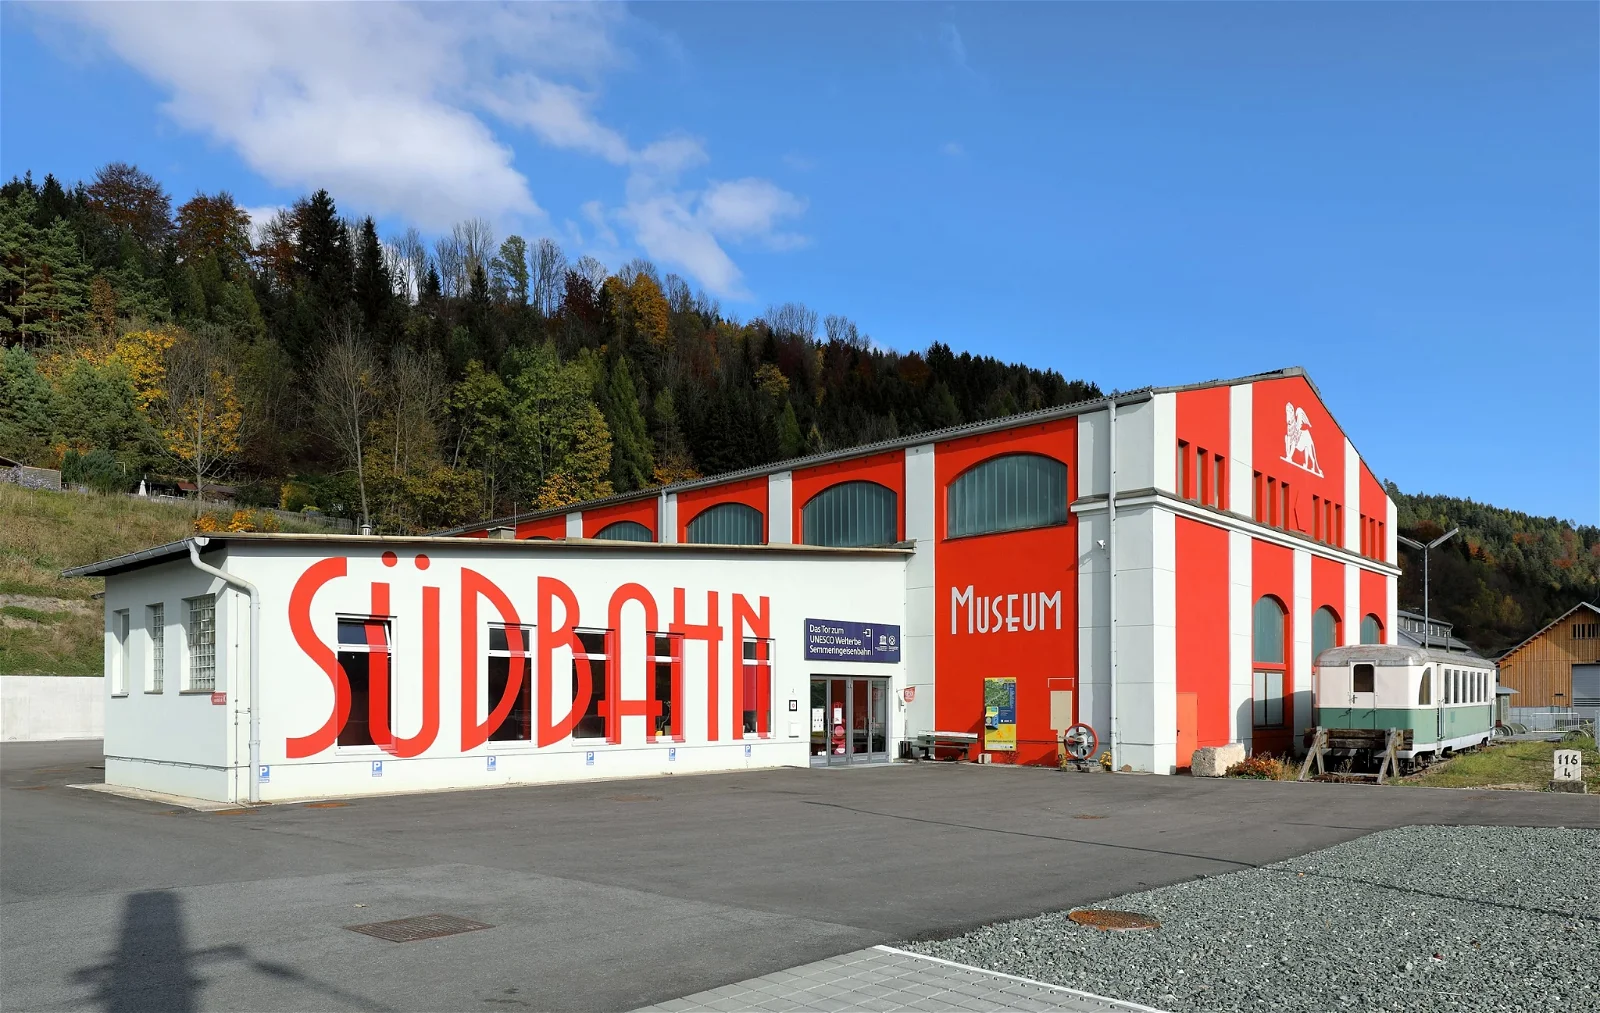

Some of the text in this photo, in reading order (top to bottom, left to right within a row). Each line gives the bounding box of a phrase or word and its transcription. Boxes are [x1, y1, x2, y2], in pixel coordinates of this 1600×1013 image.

[951, 585, 1061, 635] MUSEUM
[809, 624, 820, 633] Das
[821, 625, 830, 633] Tor
[809, 635, 861, 646] UNESCO Welterbe
[286, 551, 770, 758] SÜDBAHN
[809, 644, 871, 656] Semmeringeisenbahn
[1558, 754, 1578, 765] 116
[259, 766, 268, 777] P
[373, 762, 381, 771] P
[1564, 768, 1571, 778] 4
